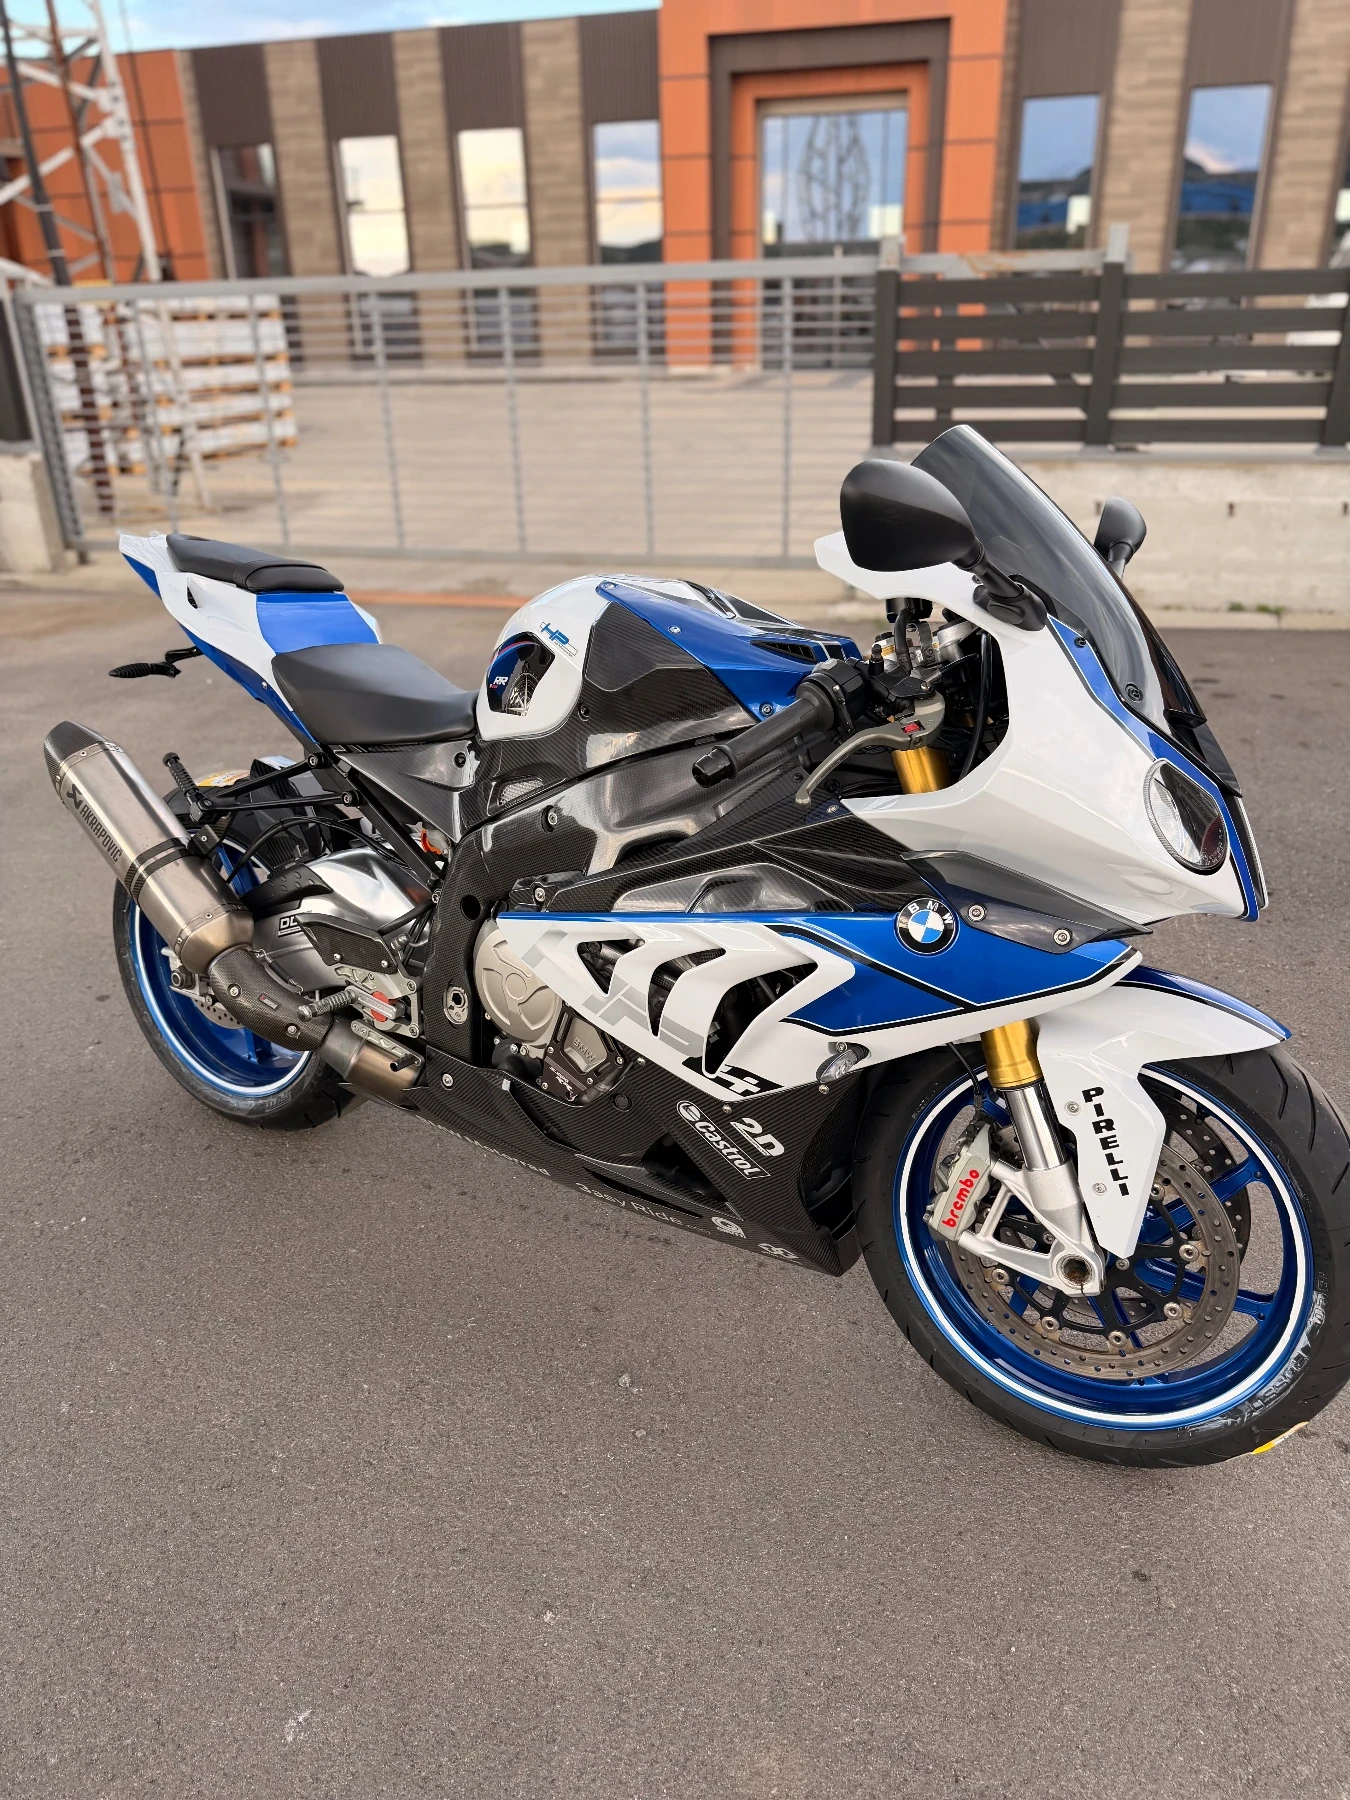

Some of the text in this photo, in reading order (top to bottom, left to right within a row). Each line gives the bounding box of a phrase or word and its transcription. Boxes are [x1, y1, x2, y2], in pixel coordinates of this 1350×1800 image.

[541, 623, 569, 645] HP
[907, 900, 954, 924] BMW
[572, 1037, 597, 1062] BMW
[694, 1121, 761, 1175] Castrol
[730, 1117, 785, 1156] 2D
[1082, 1086, 1130, 1196] PIRELLI
[942, 1169, 980, 1228] brembo
